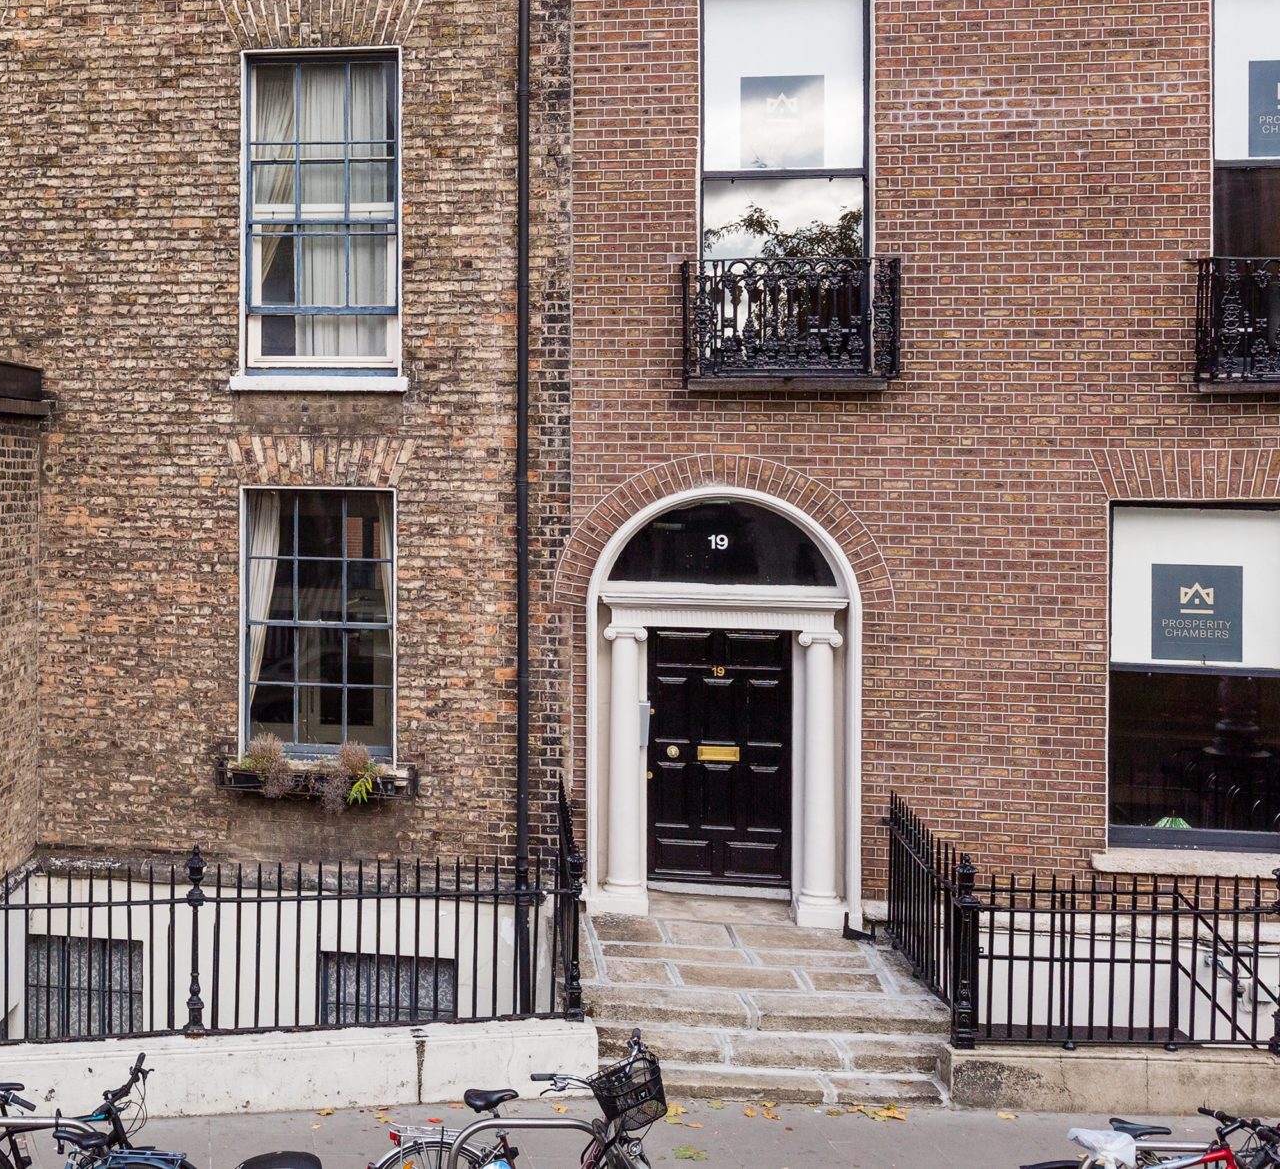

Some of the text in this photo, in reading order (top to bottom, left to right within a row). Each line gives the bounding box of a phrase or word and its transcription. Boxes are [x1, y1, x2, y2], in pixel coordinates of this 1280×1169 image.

[707, 534, 729, 550] 19
[1161, 618, 1232, 629] PROSPERITY
[1164, 628, 1229, 639] CHAMBERS
[711, 666, 725, 677] 19
